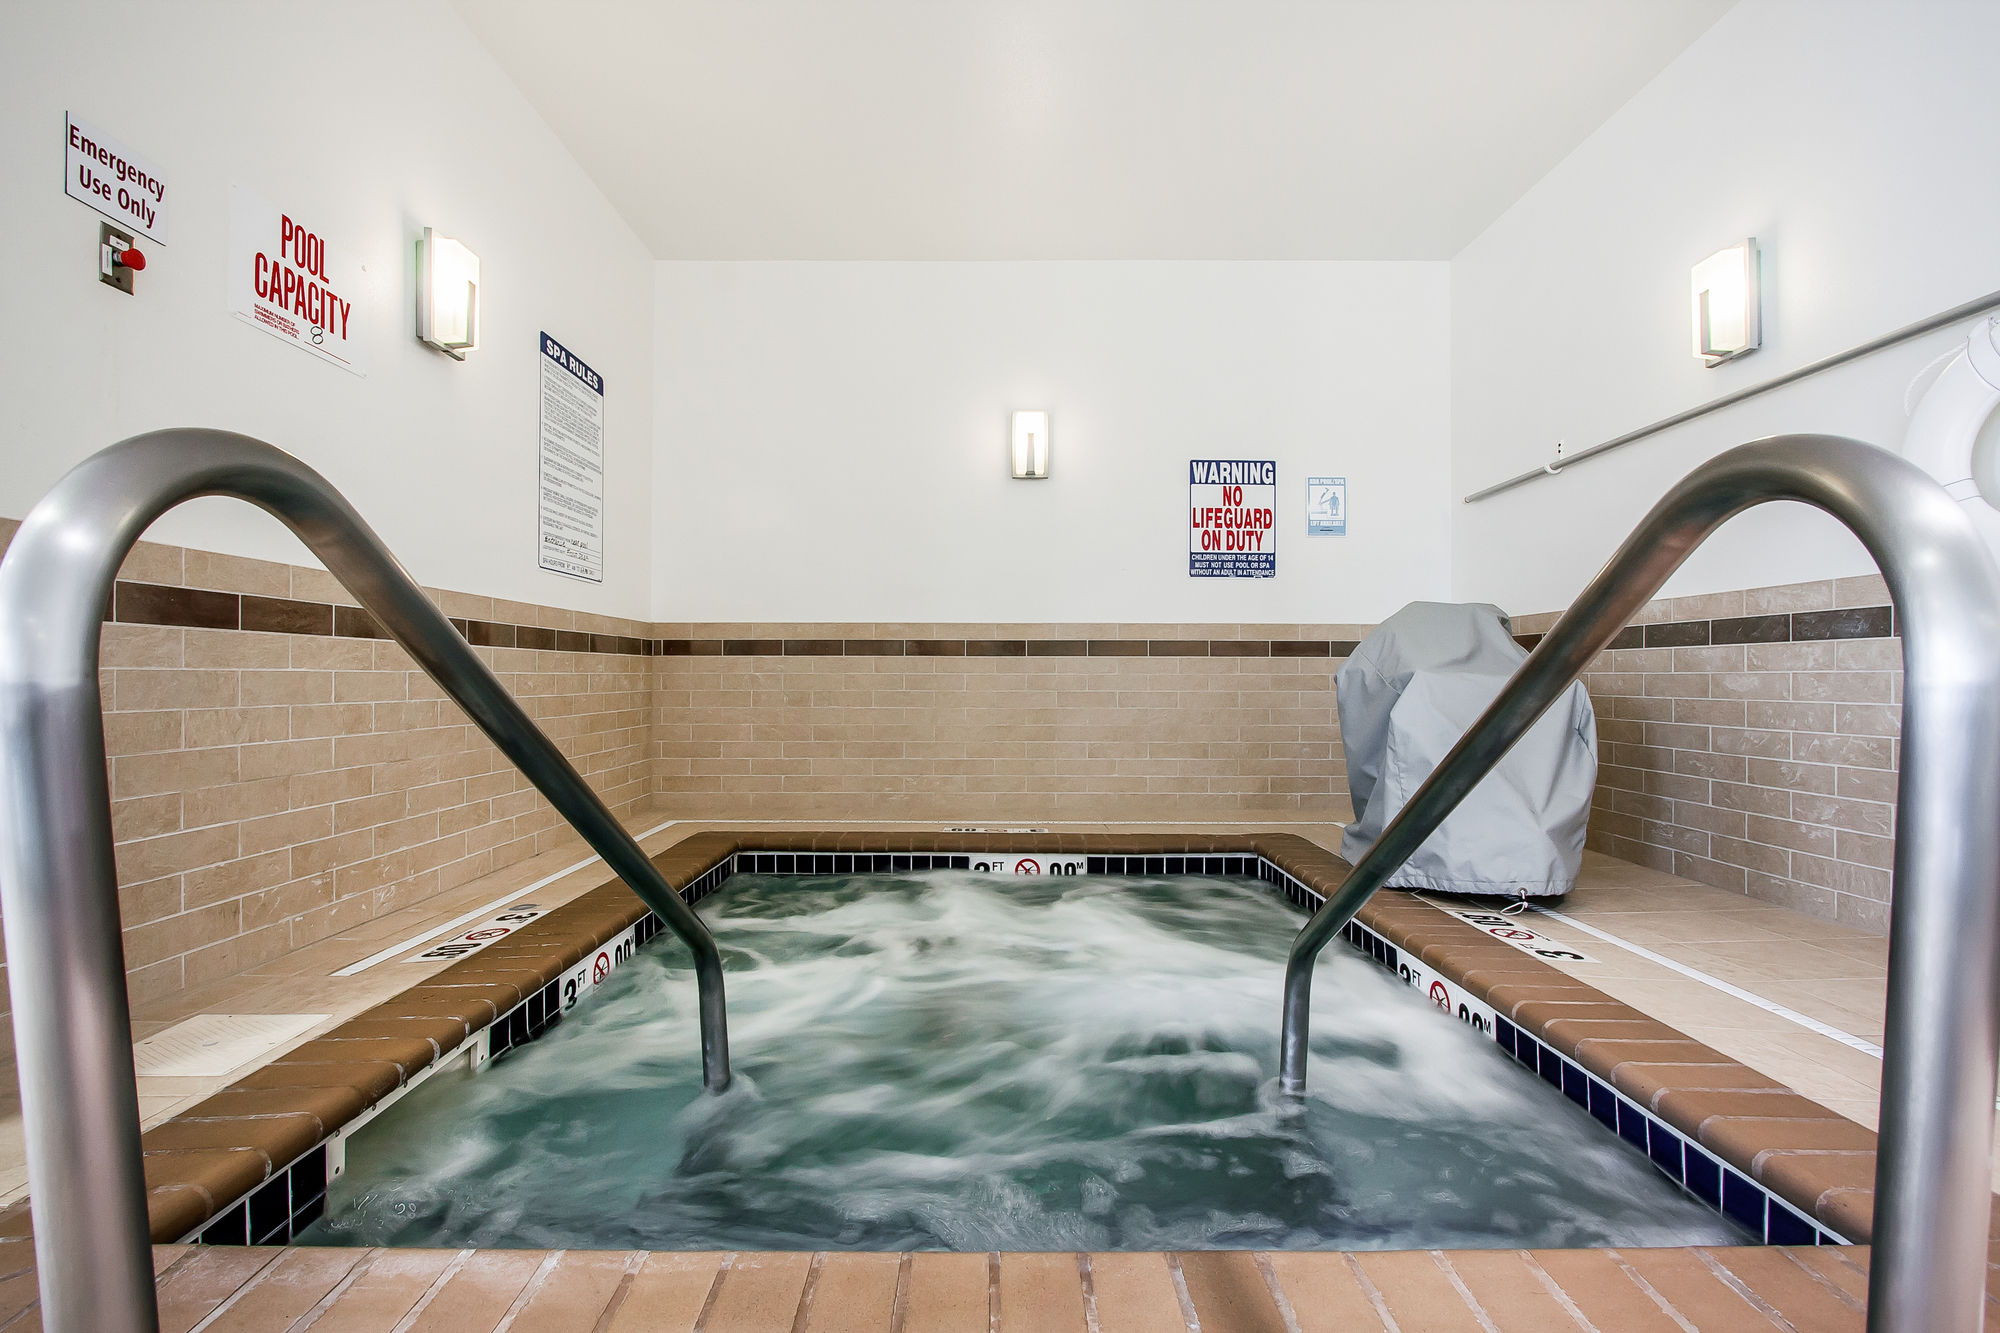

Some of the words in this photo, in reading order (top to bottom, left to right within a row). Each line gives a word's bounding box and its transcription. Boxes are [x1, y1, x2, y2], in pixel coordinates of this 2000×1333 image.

[69, 123, 165, 203] Emergency
[80, 164, 112, 201] Use
[117, 188, 156, 229] Only
[281, 213, 330, 284] POOL
[254, 252, 351, 341] CAPACITY
[254, 303, 274, 317] MAXIMUM
[274, 313, 291, 325] NUMBER
[254, 309, 277, 323] SWIMMERS
[254, 315, 274, 328] ALLOWED
[310, 326, 325, 345] 8
[546, 340, 567, 366] SPA
[569, 356, 599, 390] RULES
[1192, 462, 1274, 484] WARNING
[1223, 486, 1243, 507] NO
[1193, 508, 1273, 529] LIFEGUARD
[1201, 530, 1221, 551] ON
[1226, 530, 1264, 551] DUTY
[992, 862, 1004, 871] FT
[496, 912, 538, 922] 3
[1535, 949, 1585, 960] 3
[1412, 969, 1421, 987] FT
[564, 978, 577, 1011] 3
[578, 968, 586, 988] FT
